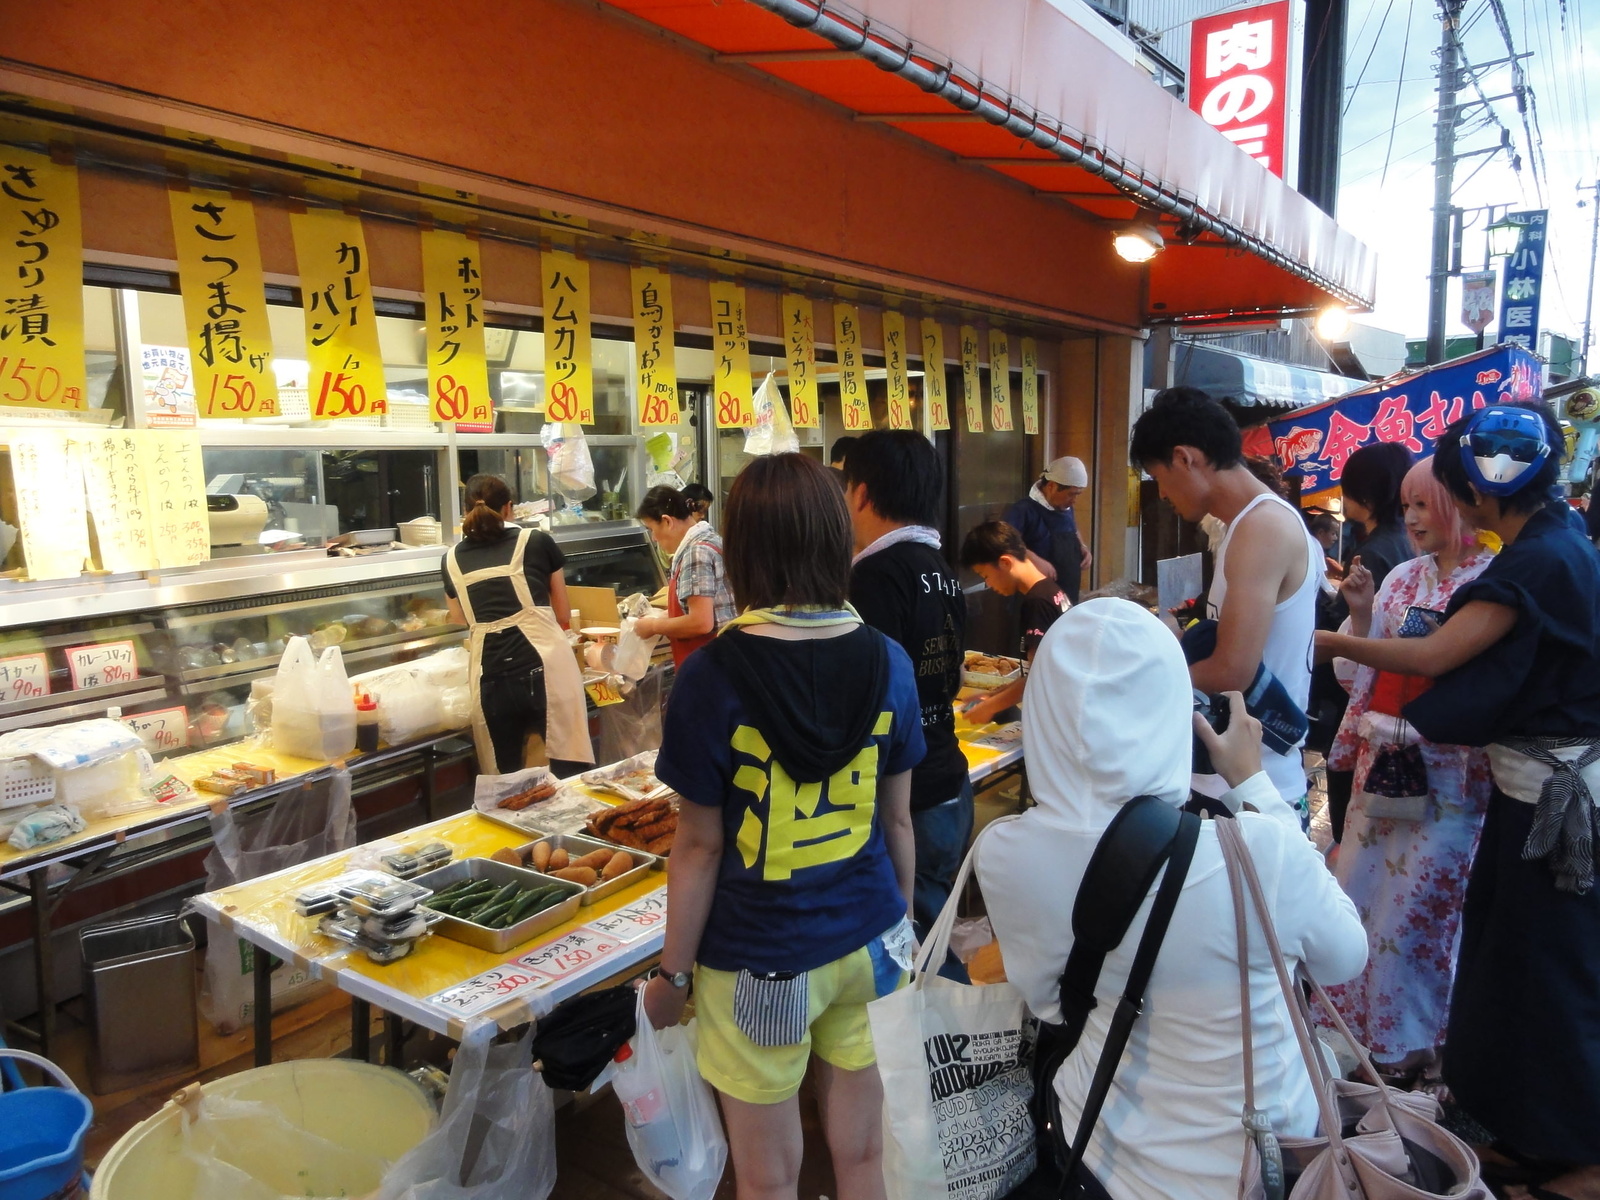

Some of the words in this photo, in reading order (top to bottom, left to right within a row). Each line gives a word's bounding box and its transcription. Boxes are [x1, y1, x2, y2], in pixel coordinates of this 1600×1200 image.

[1528, 215, 1544, 241] 内科
[1, 164, 59, 346] きゅうり漬
[191, 201, 270, 374] さつま揚げ
[336, 242, 361, 326] カレー
[458, 257, 480, 328] ホット
[310, 283, 340, 347] パン
[550, 271, 578, 382] ハムカツ
[640, 282, 663, 388] 鳥からあげ
[717, 300, 736, 379] コロッケ
[791, 309, 807, 396] メンチカツ
[840, 316, 856, 395] 鳥唐揚
[886, 330, 905, 400] やき鳥
[924, 334, 942, 397] つくね
[207, 373, 275, 415] 150円
[315, 371, 387, 417] 150円
[435, 375, 488, 421] 80円
[548, 382, 592, 422] 80円
[641, 394, 679, 424] 130円
[654, 382, 674, 400] 100g
[718, 391, 753, 426] 80円
[793, 396, 818, 427] 90円
[844, 403, 870, 428] 130円
[890, 399, 911, 429] 80円
[931, 401, 949, 426] 90円
[12, 679, 42, 700] 90円
[103, 665, 131, 684] 80円
[155, 730, 179, 748] 90円
[554, 942, 612, 971] 150円
